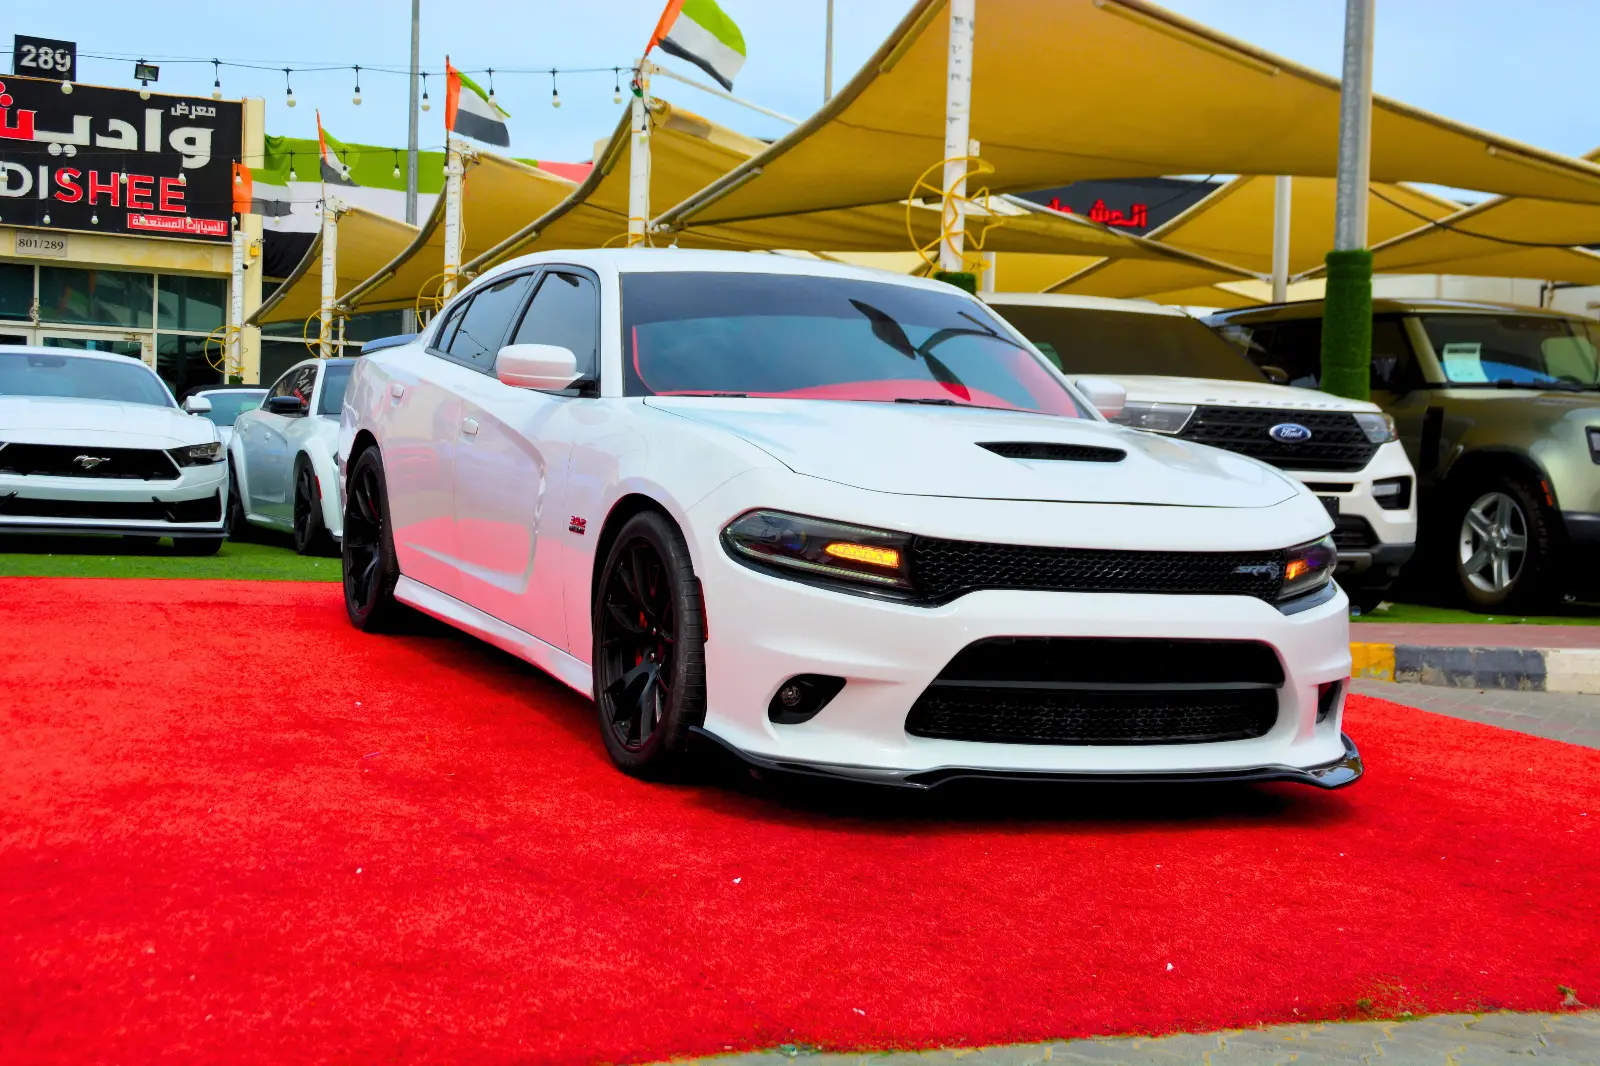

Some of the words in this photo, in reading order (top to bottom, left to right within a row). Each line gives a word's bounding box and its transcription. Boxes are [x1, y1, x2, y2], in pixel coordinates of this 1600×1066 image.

[20, 44, 71, 72] 289
[171, 101, 216, 119] معرض
[186, 219, 224, 234] للسيارات
[18, 238, 64, 251] 801/289
